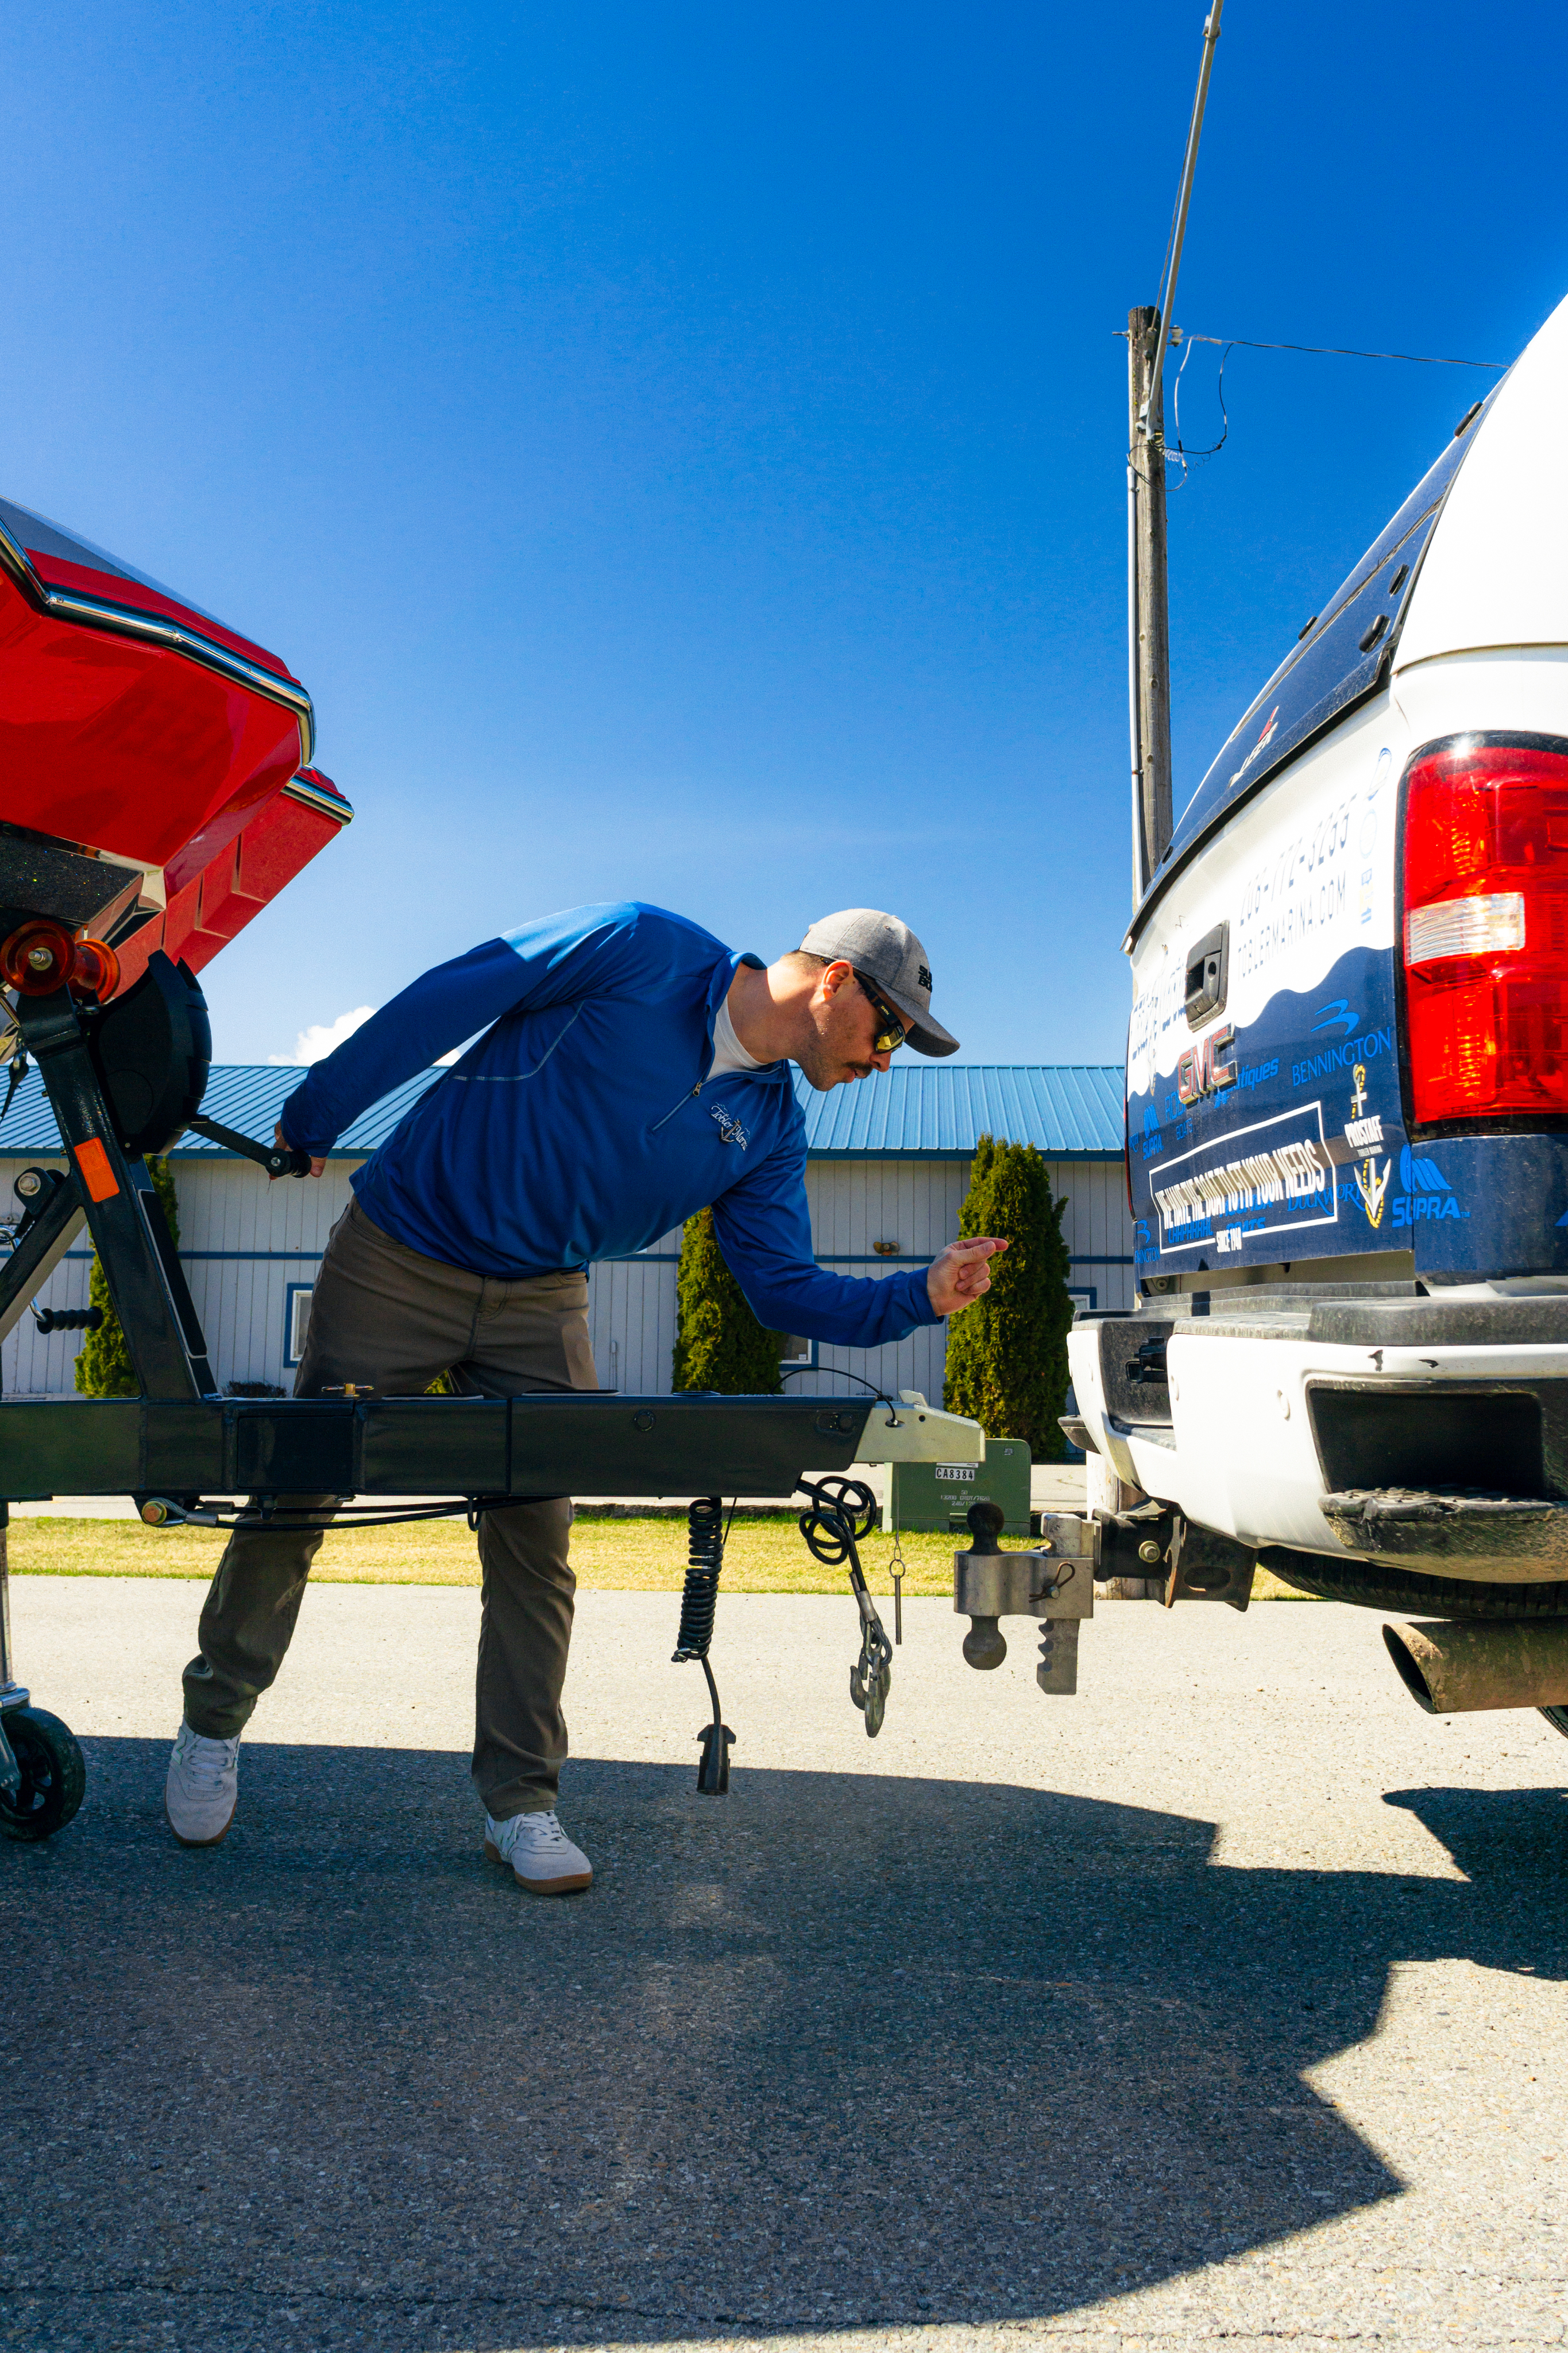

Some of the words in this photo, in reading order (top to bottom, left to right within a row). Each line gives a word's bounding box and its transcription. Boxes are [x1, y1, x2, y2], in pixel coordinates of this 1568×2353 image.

[1238, 870, 1346, 982] TOBLERMARINA.COM
[1178, 1021, 1238, 1105] GMC
[1292, 1027, 1392, 1086] BENNINGTON
[711, 1106, 733, 1128] Tobler
[1344, 1115, 1384, 1148] PROSTAFF
[1143, 1134, 1163, 1160] SUPRA
[1214, 1166, 1238, 1212] TO
[1226, 1160, 1253, 1209] FIT
[1241, 1152, 1284, 1205] YOUR
[1272, 1139, 1325, 1198] NEEDS
[1288, 1181, 1368, 1216] DUCKWORT
[1392, 1196, 1461, 1228] SUPRA
[1216, 1229, 1230, 1253] SINCE
[936, 1468, 974, 1480] CA8384
